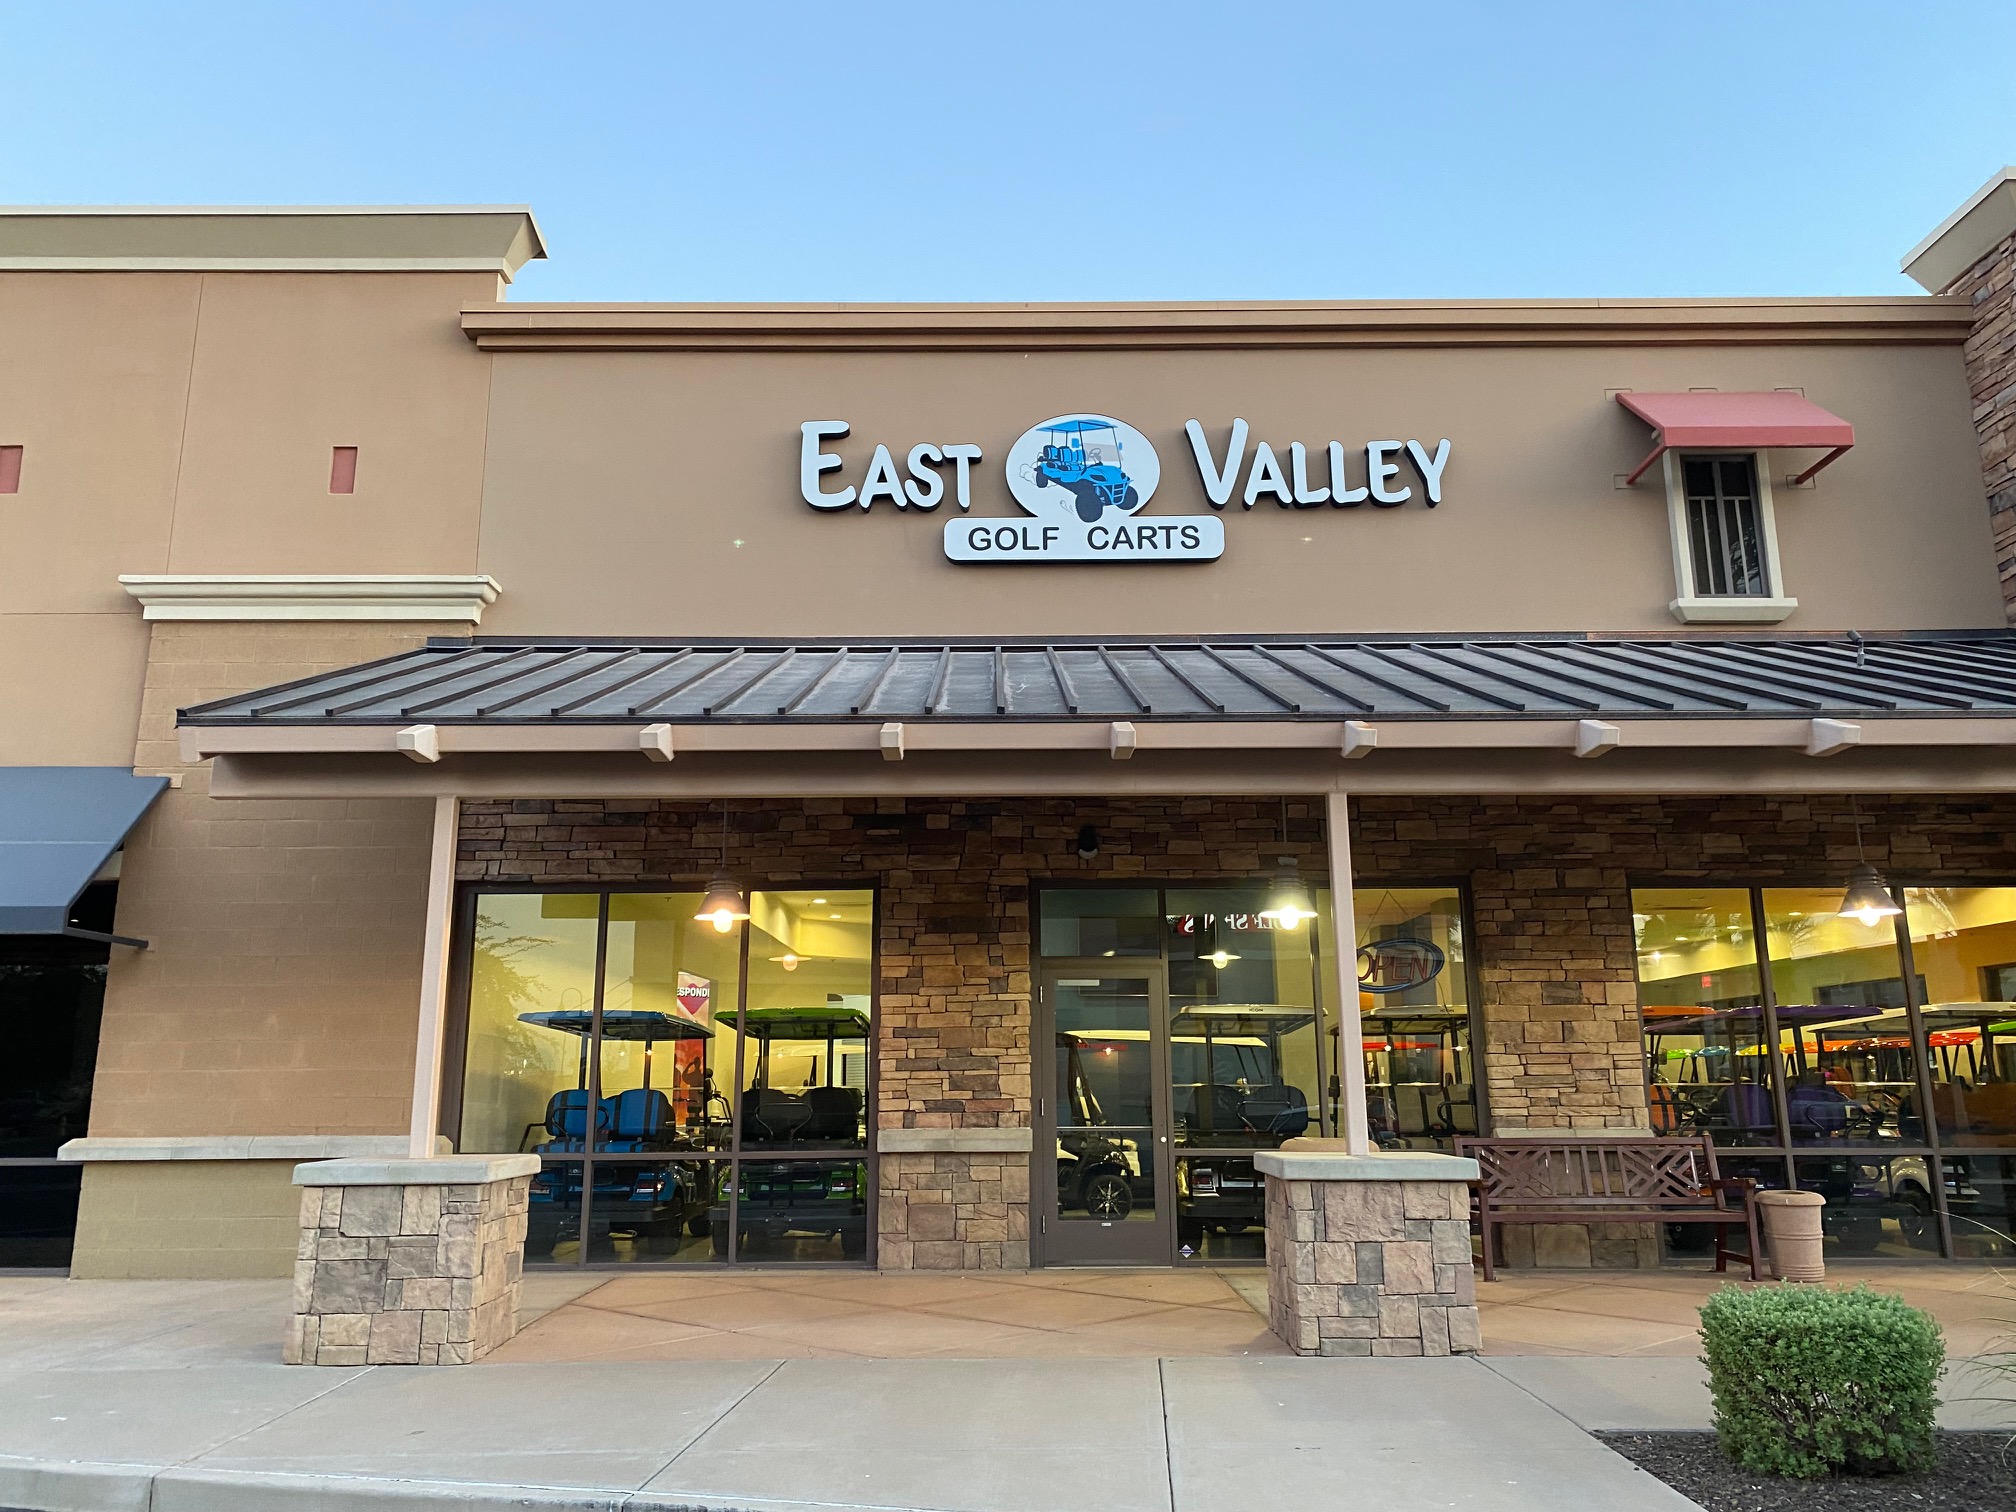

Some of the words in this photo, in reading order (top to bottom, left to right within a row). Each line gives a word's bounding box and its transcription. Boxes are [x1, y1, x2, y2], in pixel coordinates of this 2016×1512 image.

[800, 420, 983, 513] EAST
[1184, 416, 1452, 509] VALLEY
[968, 526, 1060, 551] GOLF
[1087, 525, 1200, 550] CARTS
[1357, 950, 1429, 982] OPEN
